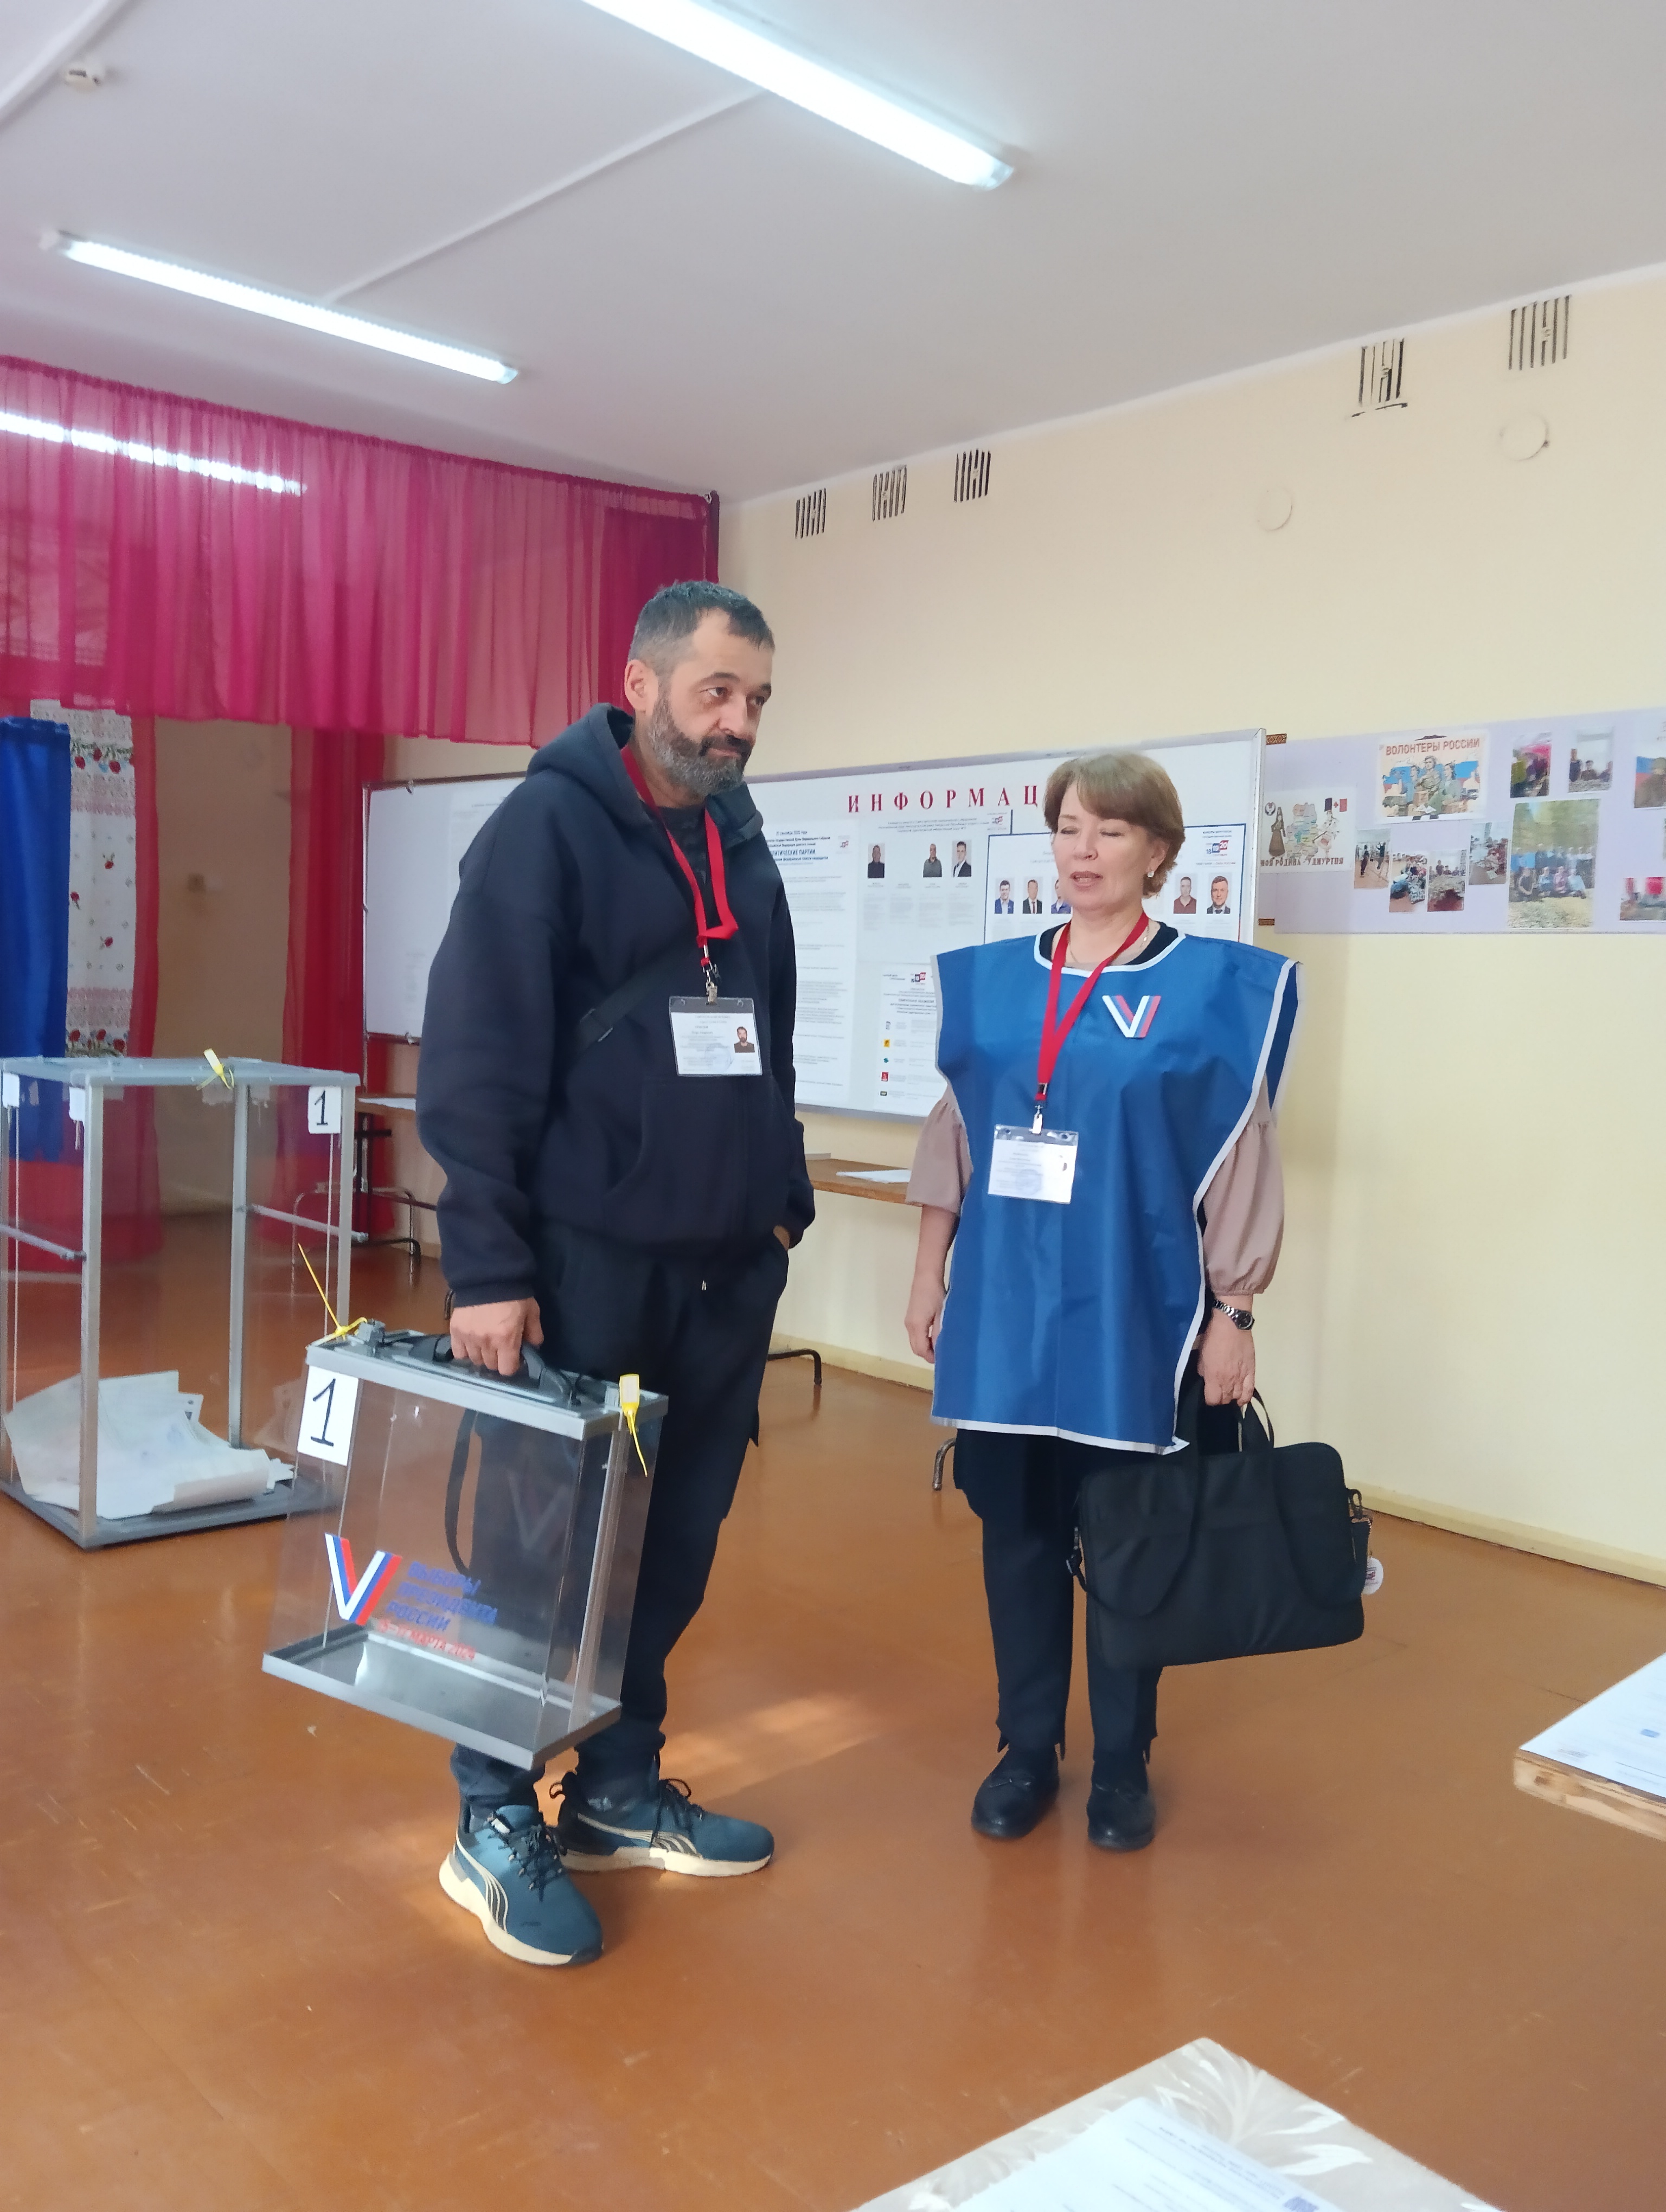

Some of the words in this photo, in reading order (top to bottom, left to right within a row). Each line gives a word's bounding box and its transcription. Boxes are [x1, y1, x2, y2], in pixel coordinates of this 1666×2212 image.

[1386, 742, 1440, 755] ВОЛОНТЕРЫ
[1443, 738, 1480, 750] РОССИИ
[315, 1090, 328, 1126] 1
[311, 1378, 336, 1447] 1
